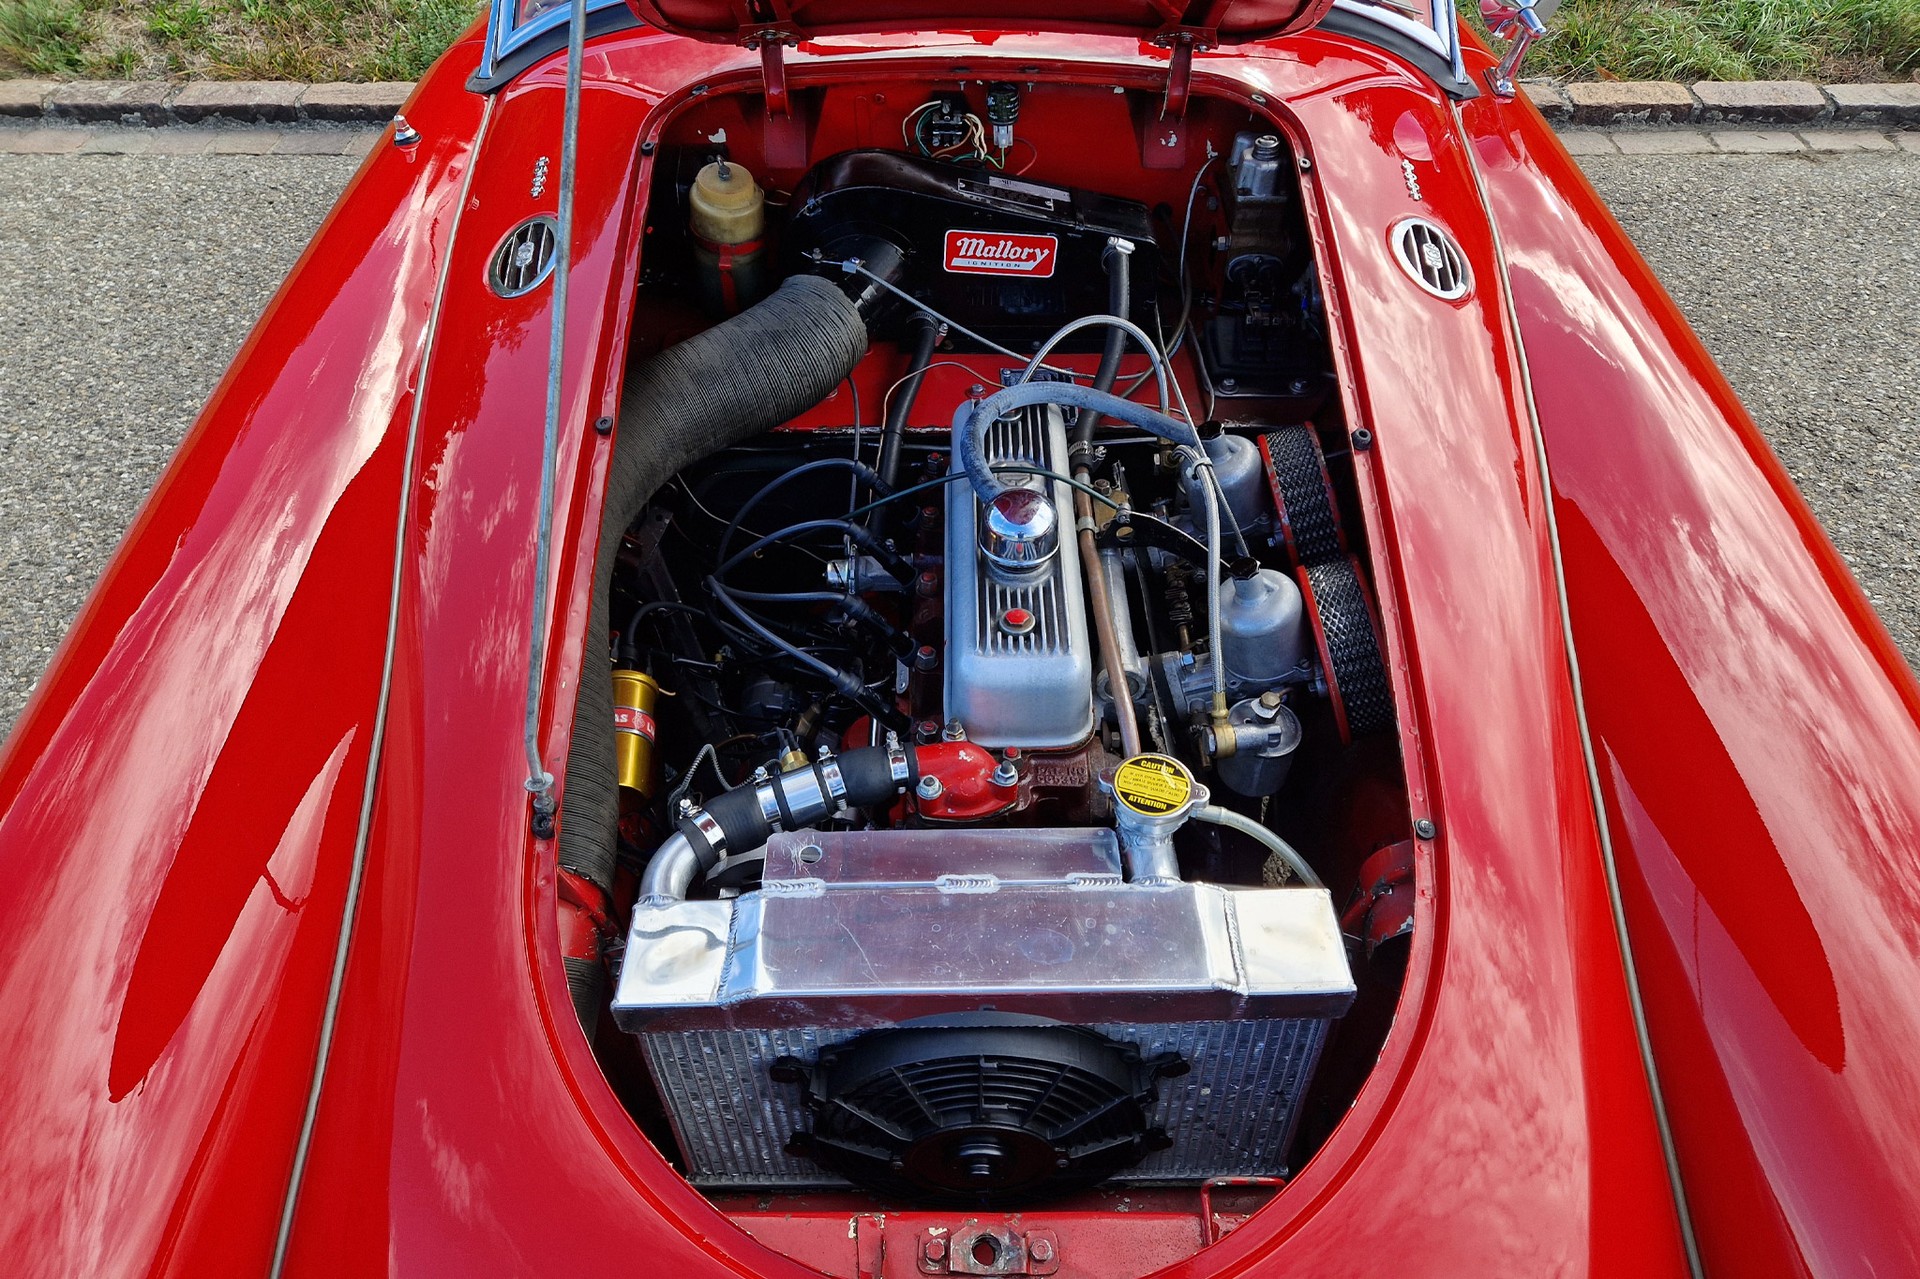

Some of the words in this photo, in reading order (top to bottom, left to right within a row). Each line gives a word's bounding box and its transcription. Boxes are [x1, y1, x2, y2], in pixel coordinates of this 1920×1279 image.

[956, 237, 1050, 262] Mallory
[967, 260, 1021, 268] IGNITION
[1140, 760, 1176, 774] CAUTION
[1128, 795, 1168, 810] ATTENTION
